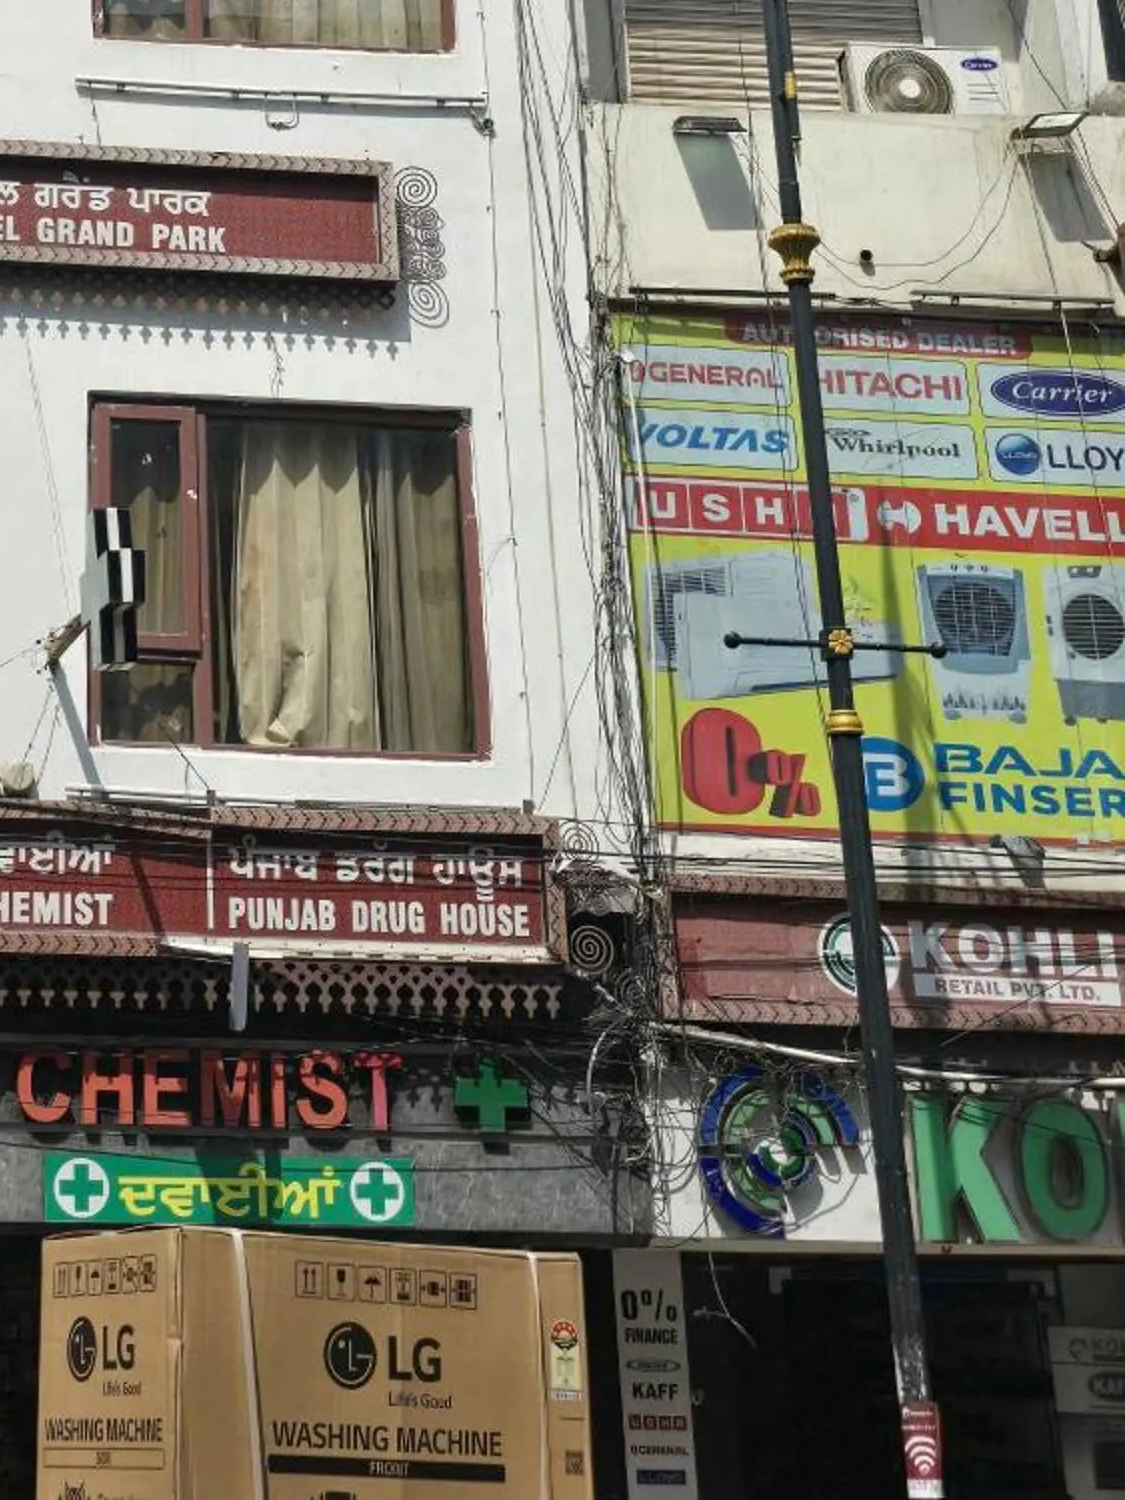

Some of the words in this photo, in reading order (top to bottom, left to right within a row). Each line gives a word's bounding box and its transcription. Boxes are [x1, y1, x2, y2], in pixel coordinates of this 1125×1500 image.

[127, 186, 212, 216] ਪਾਰਕ
[37, 218, 135, 248] GRAND
[152, 223, 227, 253] PARK
[742, 322, 909, 349] AUTORISED
[918, 332, 1017, 355] DEALER
[649, 362, 784, 389] GENERAL
[819, 369, 963, 401] HITACHI
[1012, 381, 1113, 404] Carrier
[633, 423, 789, 454] VOLTAS
[833, 437, 961, 459] Whirlpool
[649, 490, 800, 527] USH
[681, 707, 821, 818] 0%
[228, 897, 336, 932] PUNJAB
[352, 900, 426, 934] DRUG
[440, 903, 530, 937] HOUSE
[907, 919, 1118, 978] KOHLI
[934, 977, 1005, 996] RETAIL
[1060, 984, 1101, 1002] LTD.
[17, 1047, 404, 1132] CHEMIST
[909, 1096, 1125, 1243] KO
[117, 1163, 343, 1219] ਦਵਾਈਆਂ
[621, 1287, 678, 1322] 0%
[102, 1324, 136, 1370] LG
[625, 1327, 679, 1345] FINANCE
[388, 1335, 442, 1383] LG
[632, 1382, 680, 1400] KAFF
[45, 1417, 104, 1441] WASHING
[107, 1418, 163, 1442] MACHINE
[273, 1419, 389, 1452] WASHING
[396, 1426, 503, 1457] MACHINE
